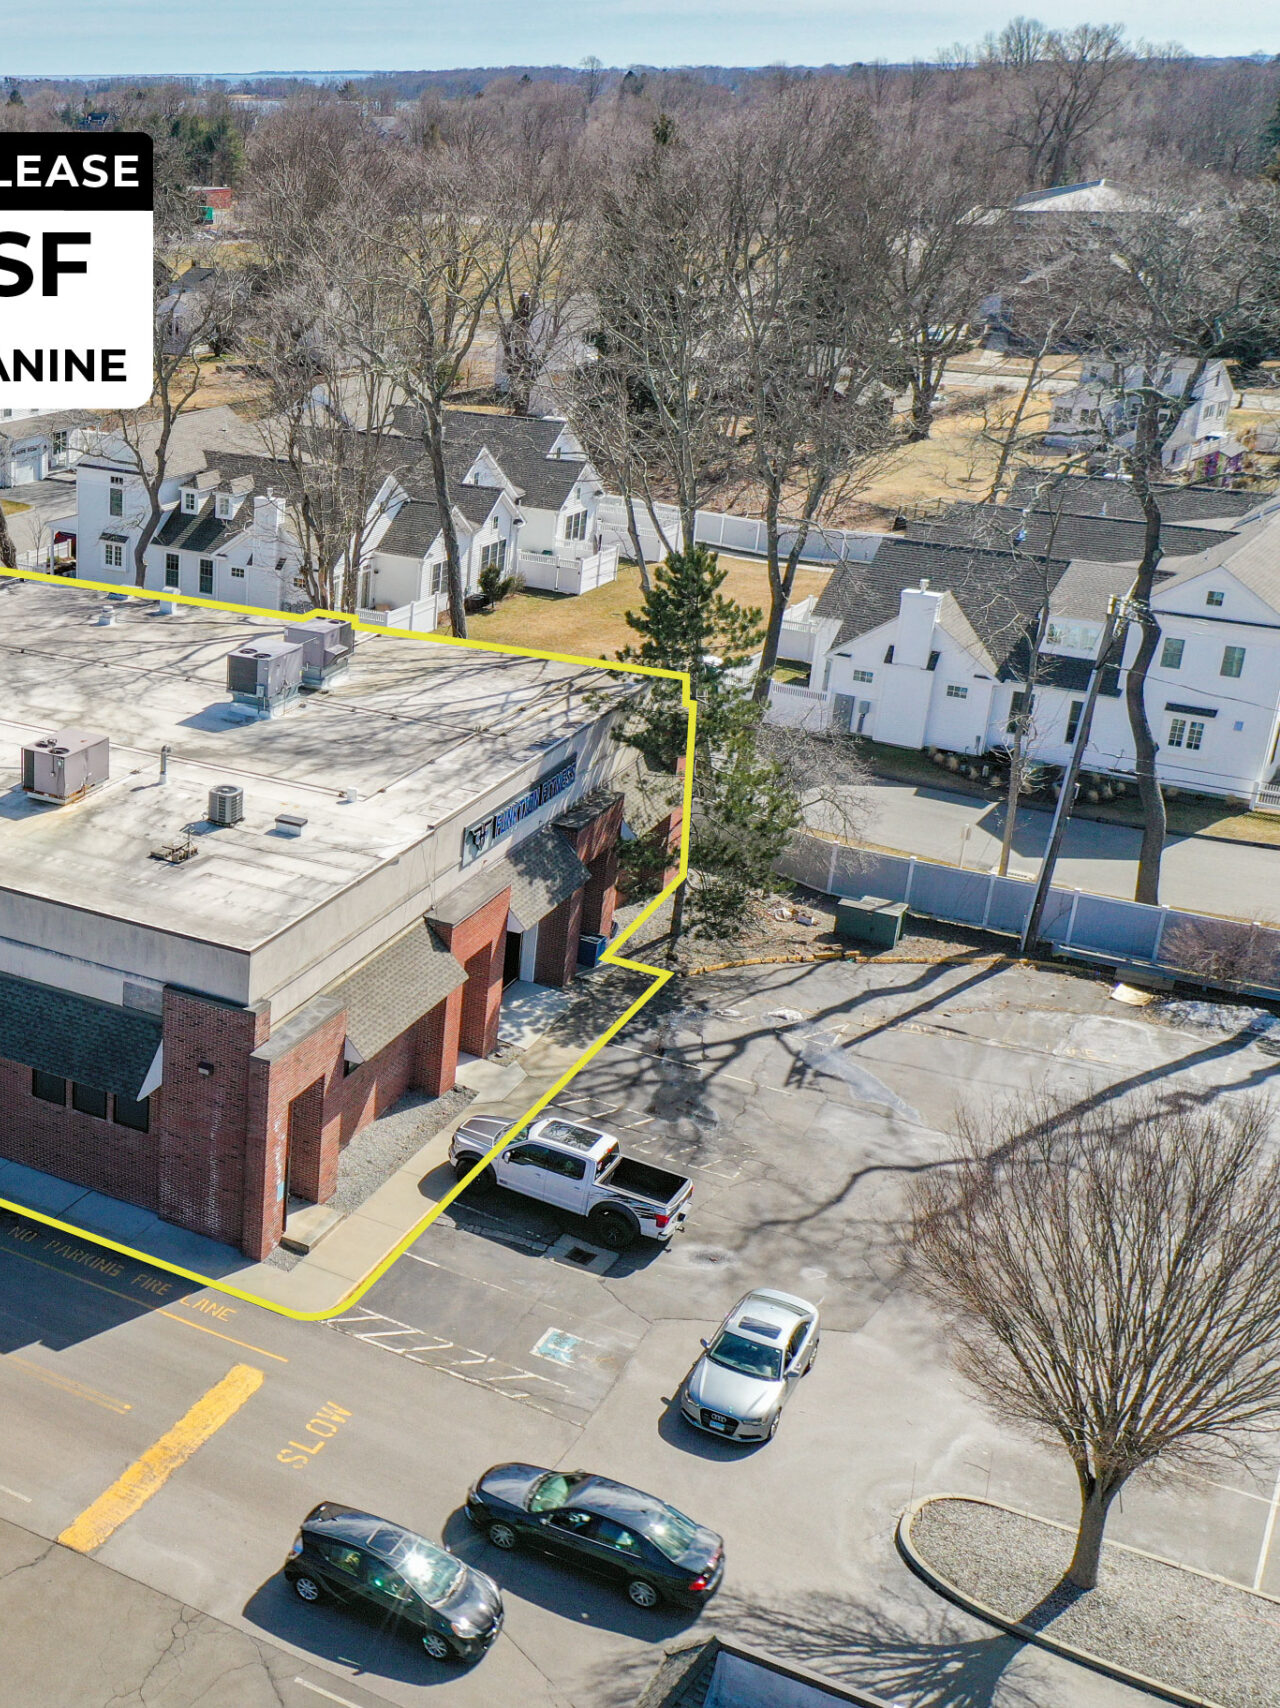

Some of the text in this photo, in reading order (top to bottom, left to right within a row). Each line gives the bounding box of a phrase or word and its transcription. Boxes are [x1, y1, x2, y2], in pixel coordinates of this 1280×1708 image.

[8, 1225, 237, 1321] NO PARKING FIRE LANE
[277, 1401, 353, 1469] SLOW
